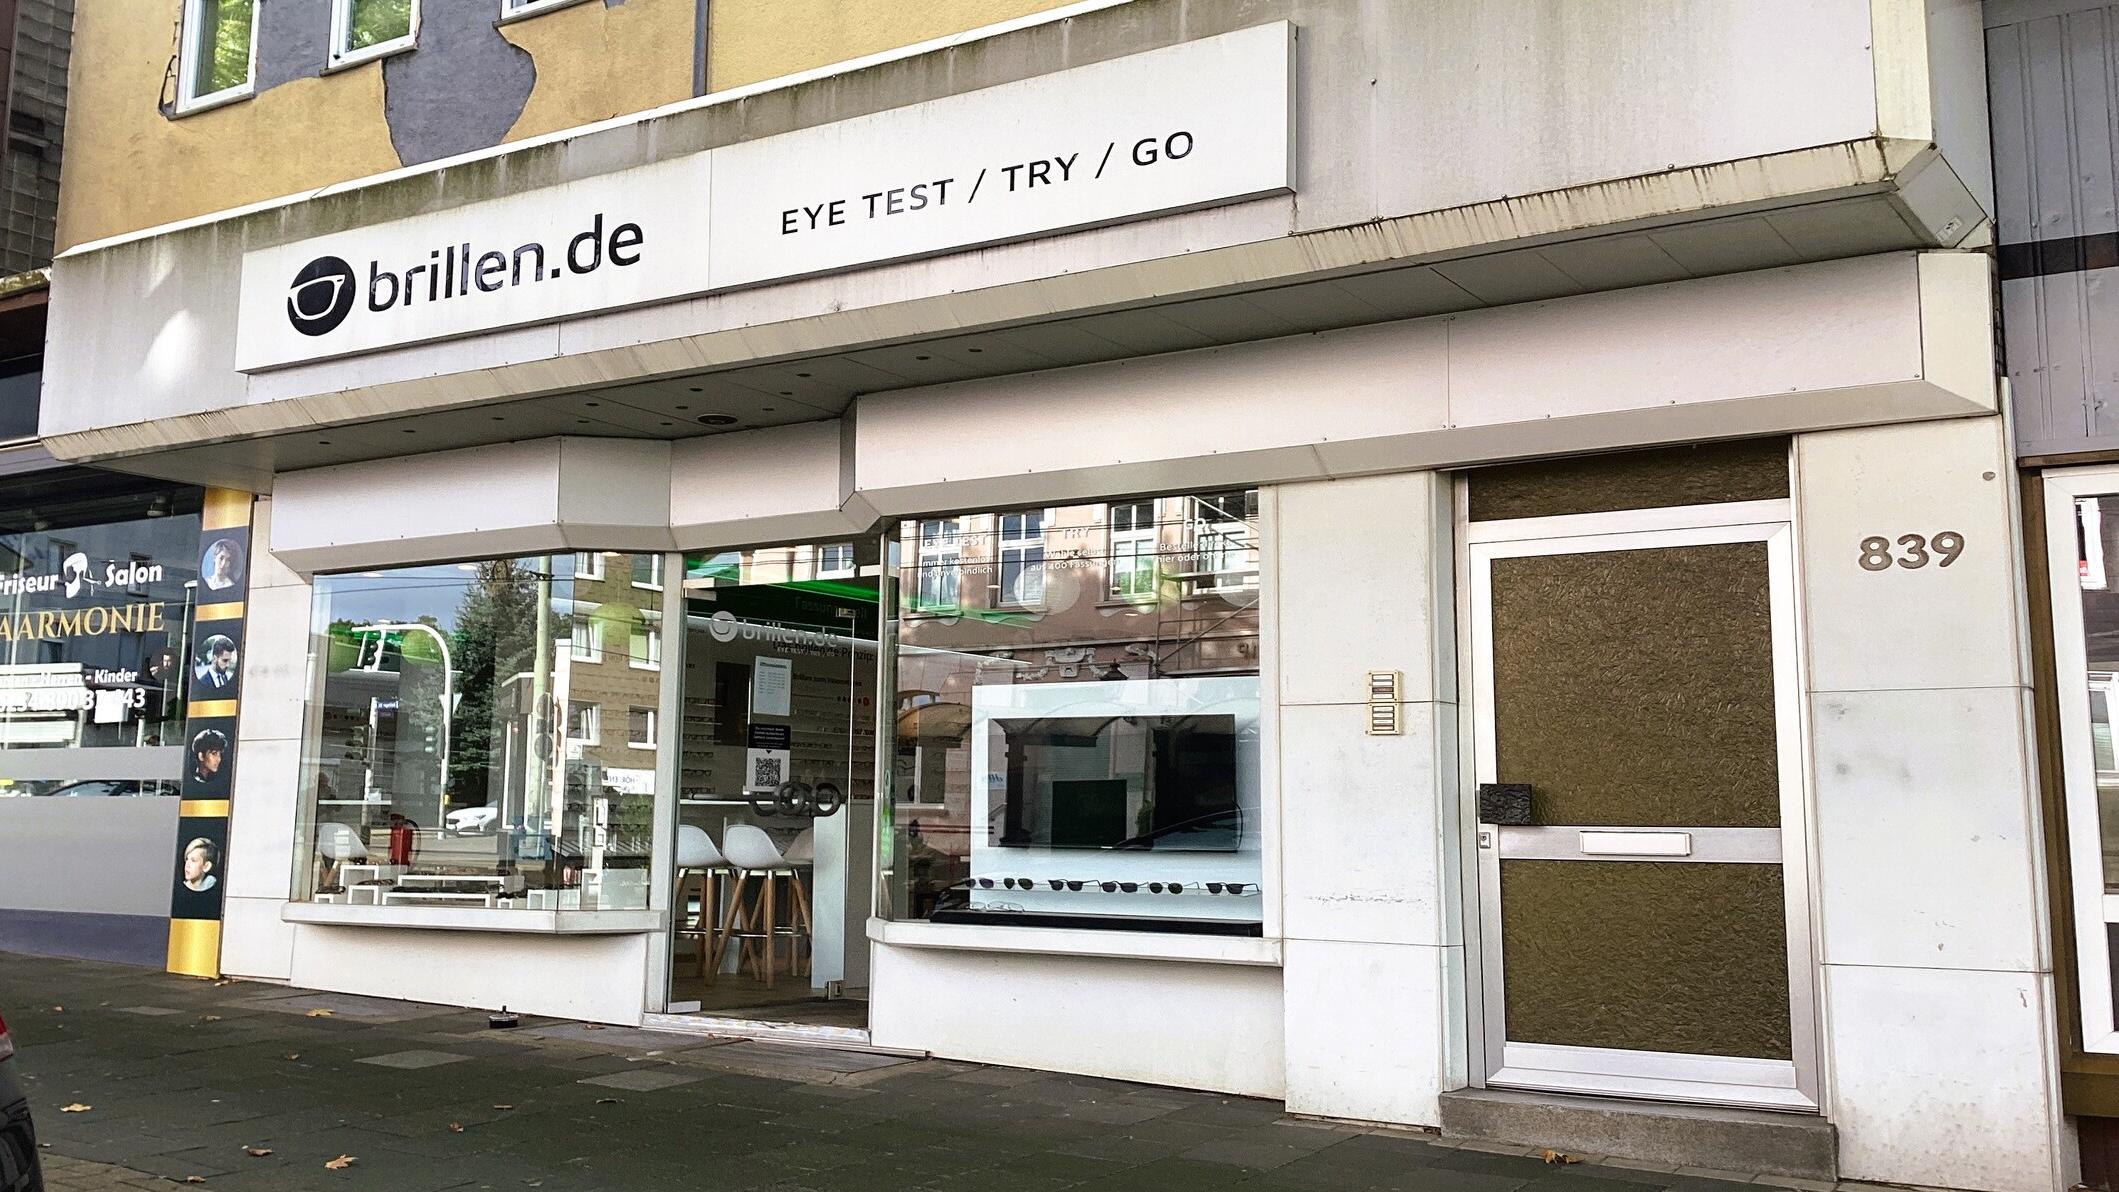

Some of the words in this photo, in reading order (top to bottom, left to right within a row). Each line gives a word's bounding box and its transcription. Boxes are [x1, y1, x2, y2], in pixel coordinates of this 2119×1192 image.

[782, 200, 846, 235] EYE
[862, 178, 954, 219] TEST
[968, 168, 986, 203] /
[1001, 153, 1079, 192] TRY
[1095, 142, 1114, 178] /
[1132, 131, 1194, 167] GO
[369, 214, 644, 313] brillen.de
[920, 557, 948, 567] mmer
[1858, 531, 1965, 571] 839
[105, 562, 163, 588] Salon
[743, 618, 838, 647] brillen.de
[95, 668, 138, 684] Kinder
